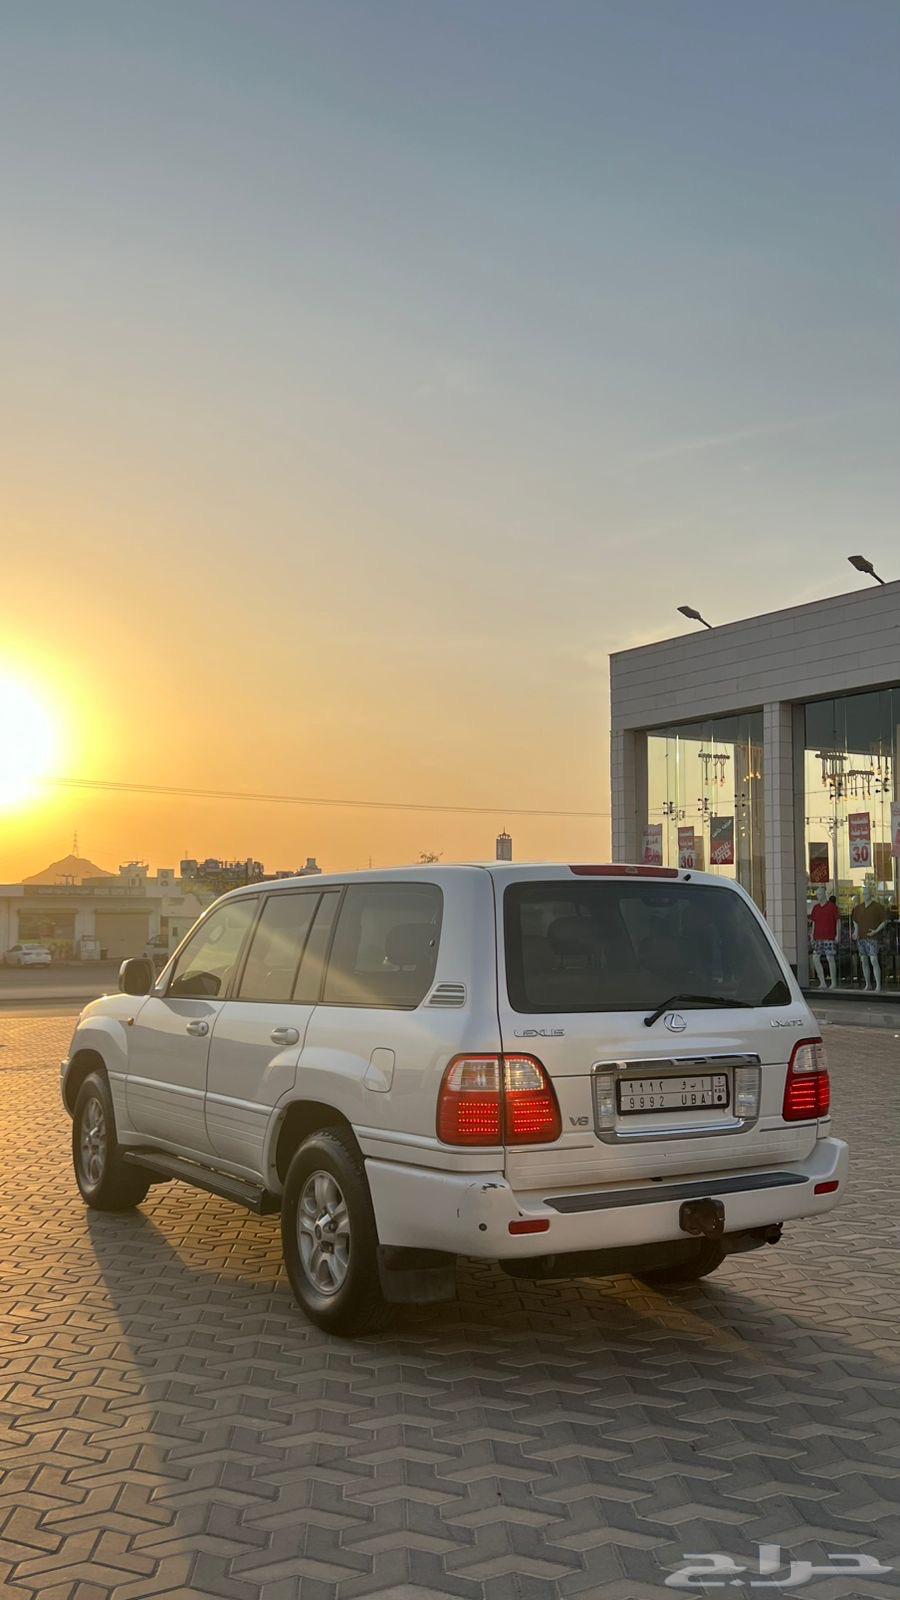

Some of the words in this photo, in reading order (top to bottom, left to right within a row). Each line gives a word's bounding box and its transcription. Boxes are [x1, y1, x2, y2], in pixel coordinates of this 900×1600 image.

[853, 845, 869, 862] 30
[680, 855, 694, 868] 30
[512, 1028, 566, 1038] LEXUS
[629, 1095, 665, 1109] 9992
[681, 1093, 707, 1106] UBA
